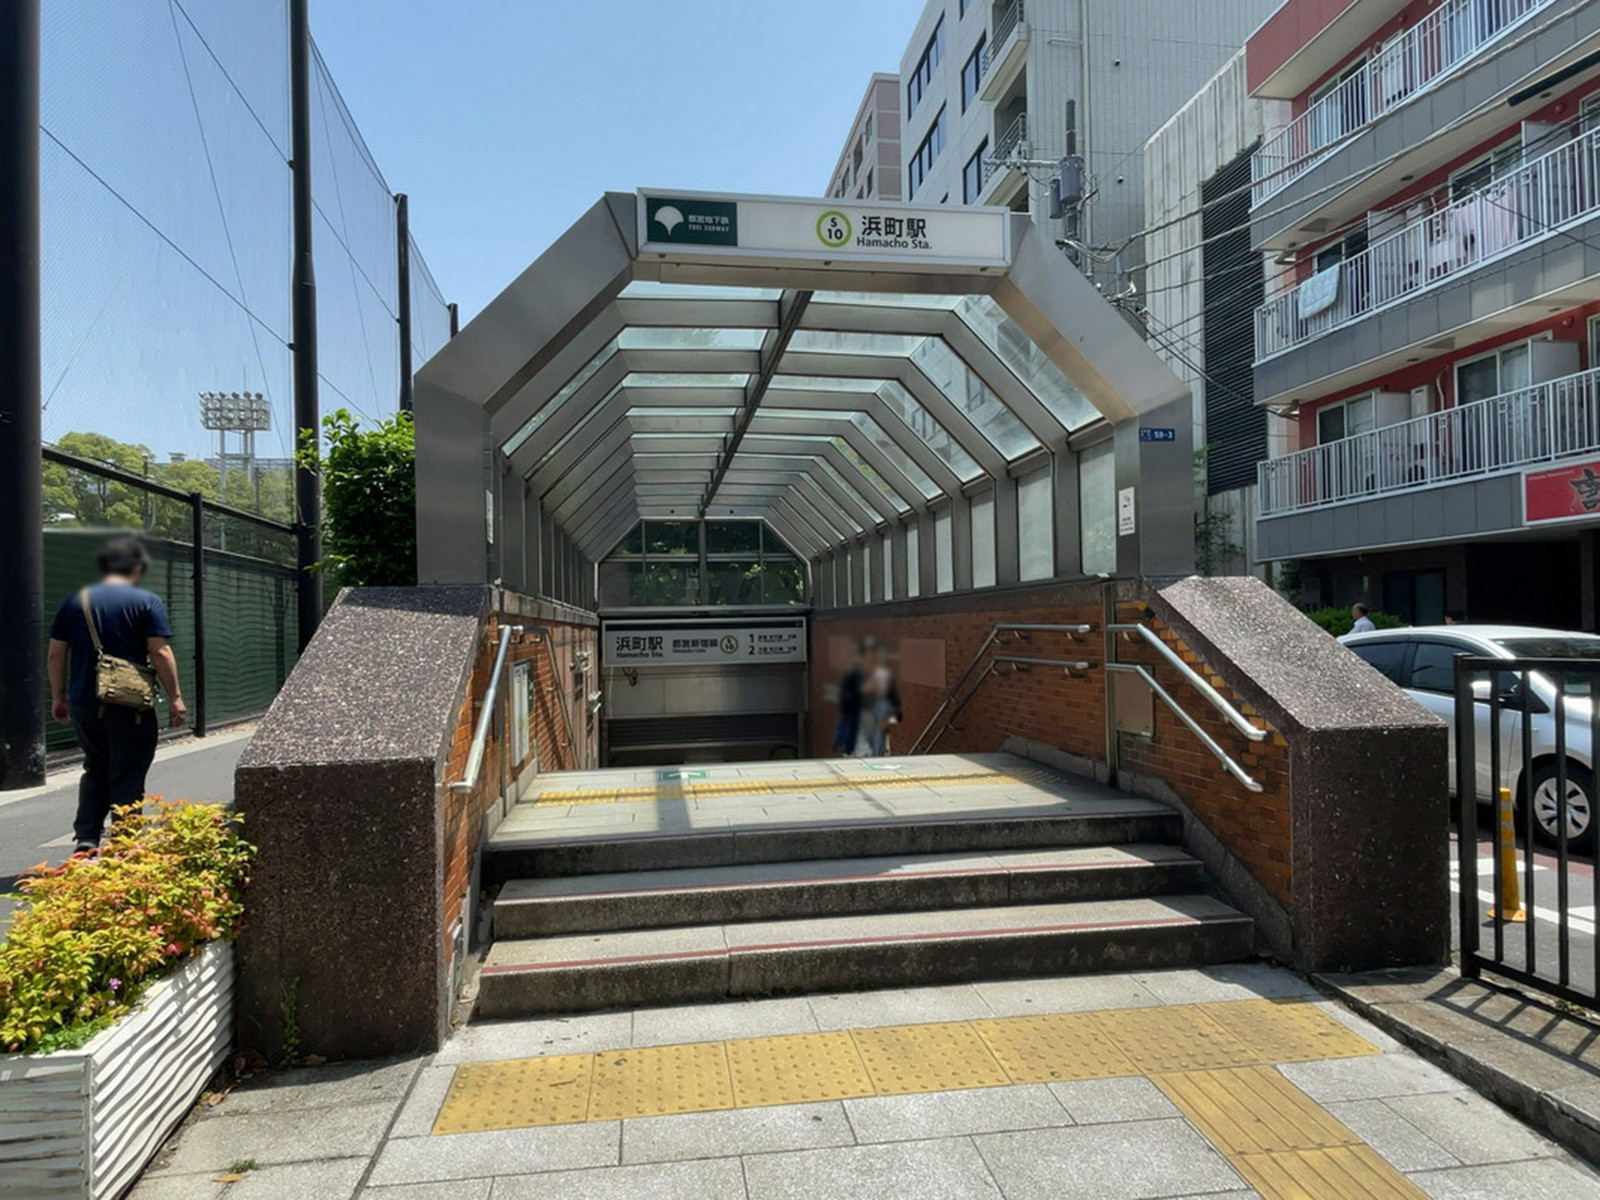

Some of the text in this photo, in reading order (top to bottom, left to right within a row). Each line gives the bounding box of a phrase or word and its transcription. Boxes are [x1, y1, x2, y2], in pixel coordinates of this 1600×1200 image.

[830, 217, 838, 228] S
[861, 215, 927, 239] 浜町駅
[827, 228, 843, 240] 10
[857, 237, 933, 250] Hamacho Sta.
[616, 636, 663, 651] 浜町駅
[749, 633, 754, 643] 1
[748, 645, 755, 655] 2
